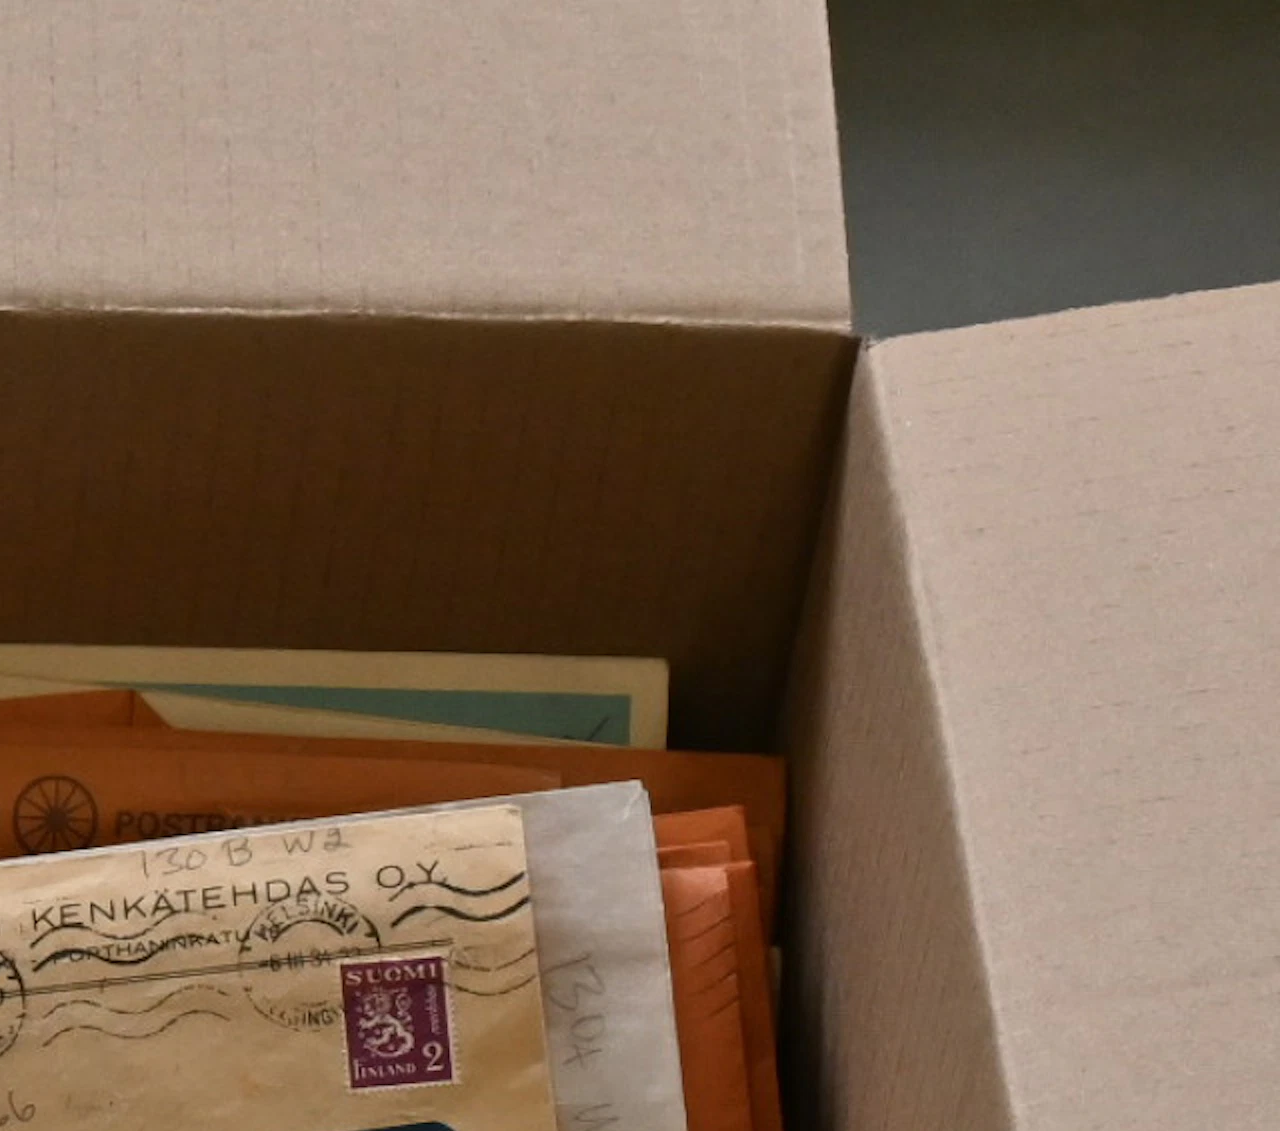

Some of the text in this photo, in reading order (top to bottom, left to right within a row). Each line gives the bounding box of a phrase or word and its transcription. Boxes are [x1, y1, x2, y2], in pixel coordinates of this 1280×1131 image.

[138, 848, 208, 879] 130
[31, 869, 351, 931] KENKÄTEHDAS
[344, 961, 439, 987] SUOMI
[353, 1059, 417, 1082] FINLAND
[422, 1041, 445, 1073] 2
